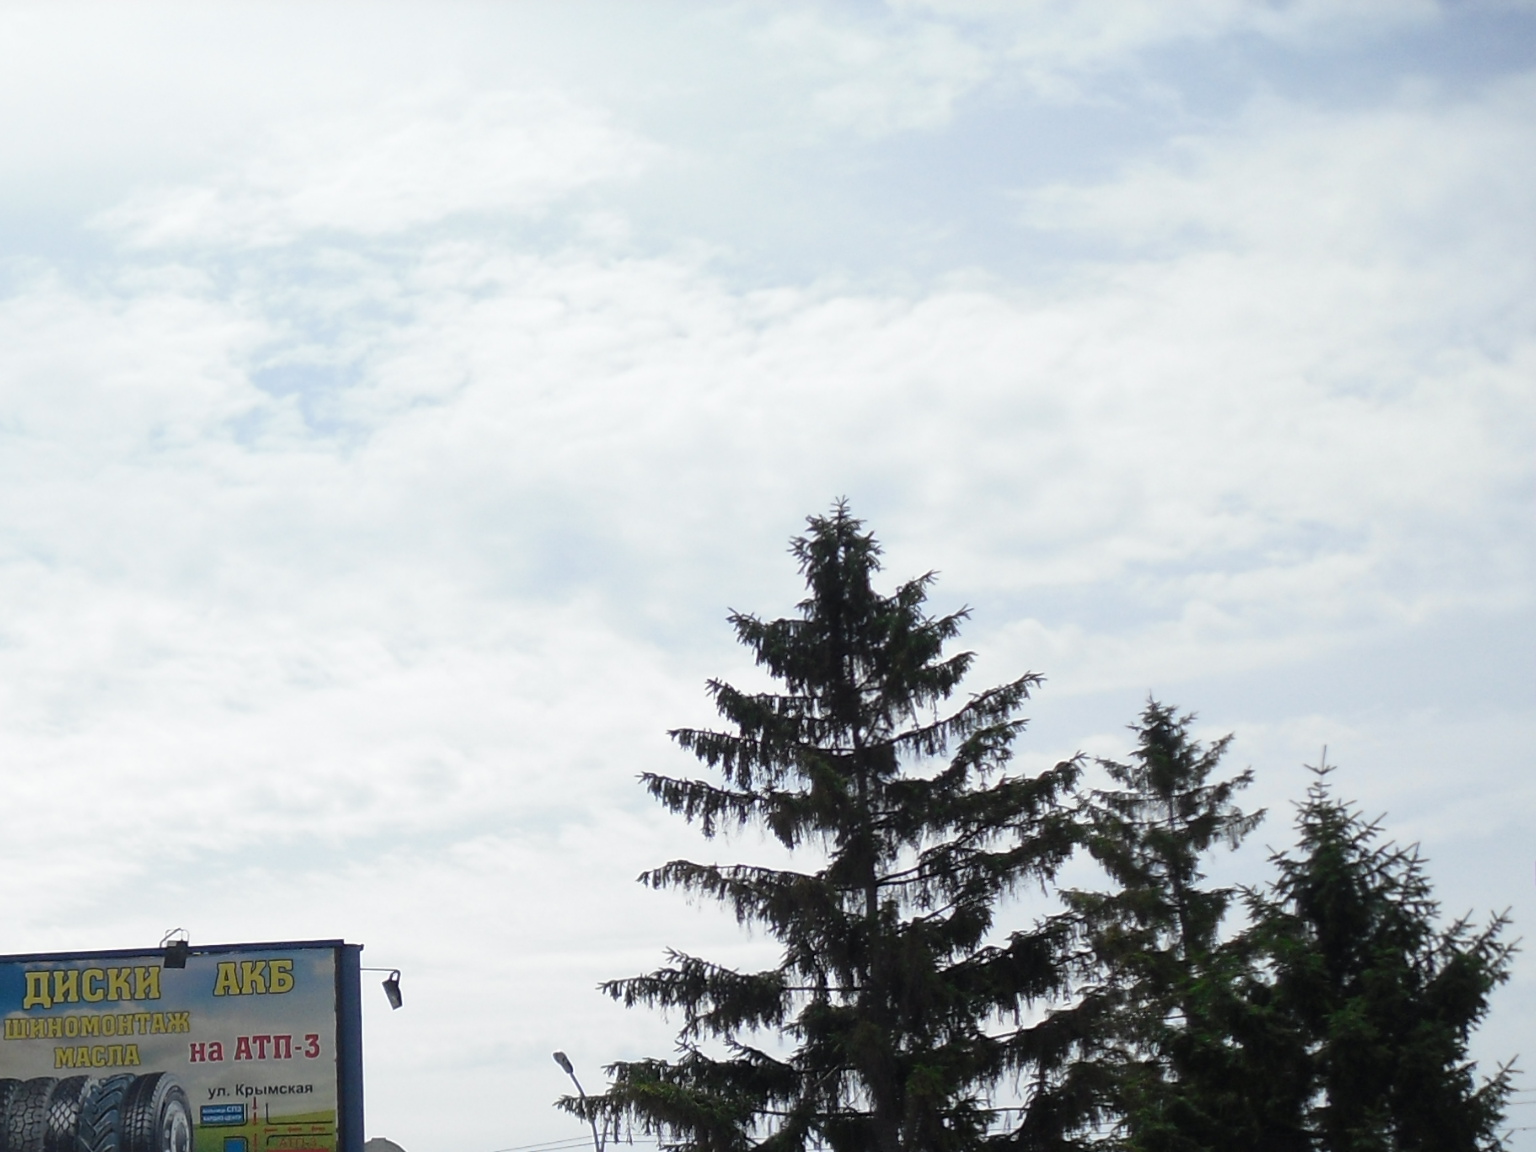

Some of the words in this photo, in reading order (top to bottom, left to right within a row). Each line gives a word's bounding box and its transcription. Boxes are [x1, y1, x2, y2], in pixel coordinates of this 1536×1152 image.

[23, 966, 161, 1009] ДИСКИ
[213, 959, 295, 996] АКБ
[3, 1011, 191, 1040] ШИНОМОНТАЖ
[54, 1044, 141, 1069] МАСЛА
[189, 1042, 224, 1062] на
[234, 1034, 320, 1060] АТП-3
[207, 1087, 230, 1099] ул.
[235, 1084, 314, 1097] Крымская
